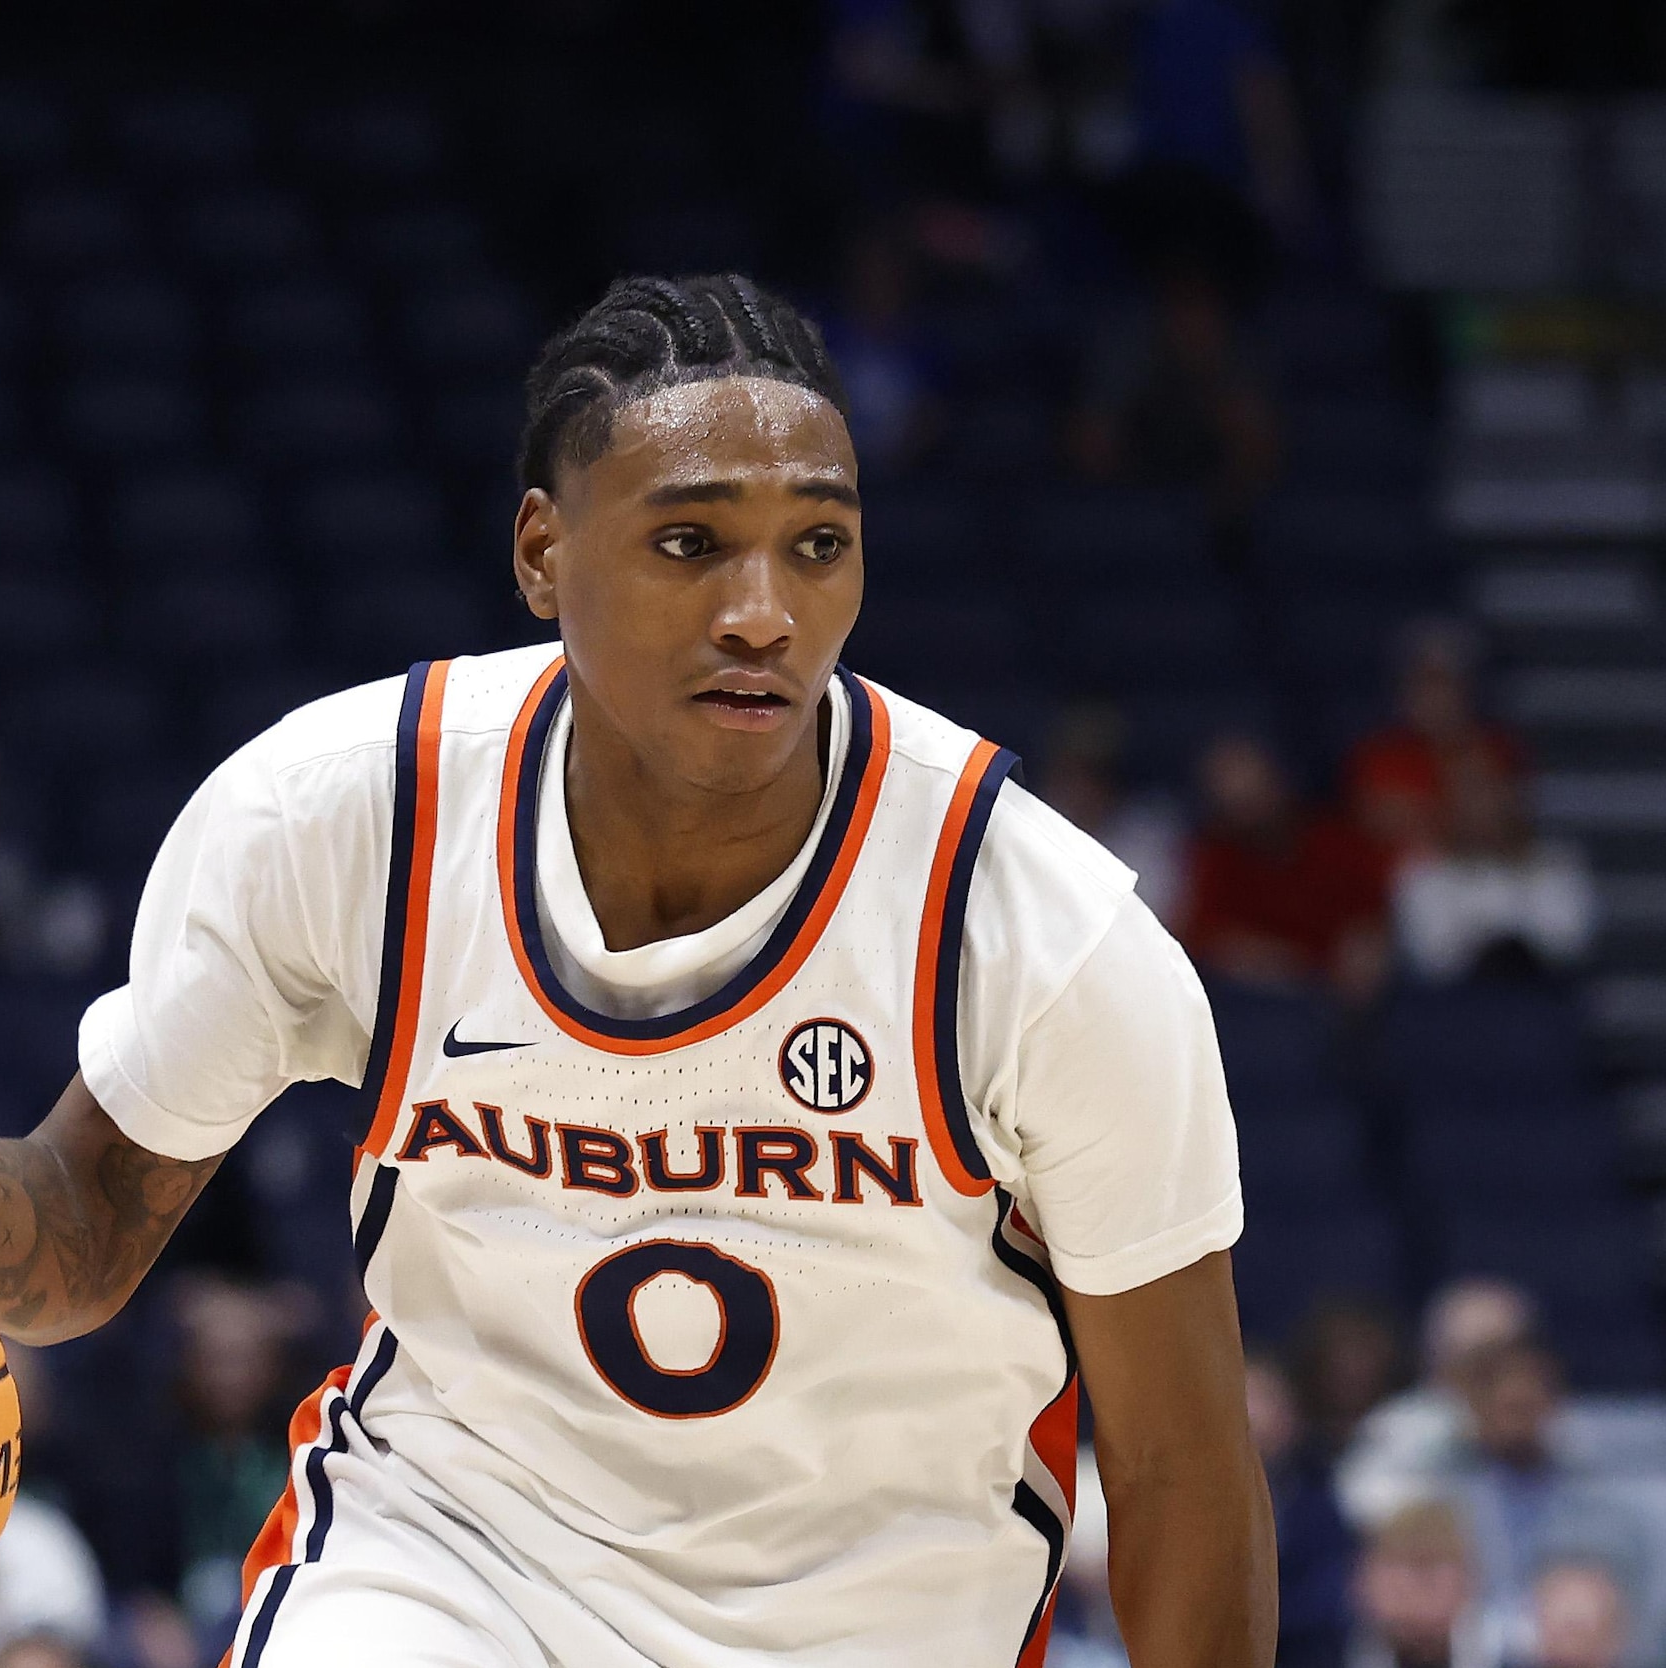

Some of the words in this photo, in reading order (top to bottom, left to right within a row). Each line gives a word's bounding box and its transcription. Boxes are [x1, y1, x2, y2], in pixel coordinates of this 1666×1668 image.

[786, 1024, 867, 1108] SEC
[395, 1097, 924, 1207] AUBURN
[574, 1237, 780, 1419] 0
